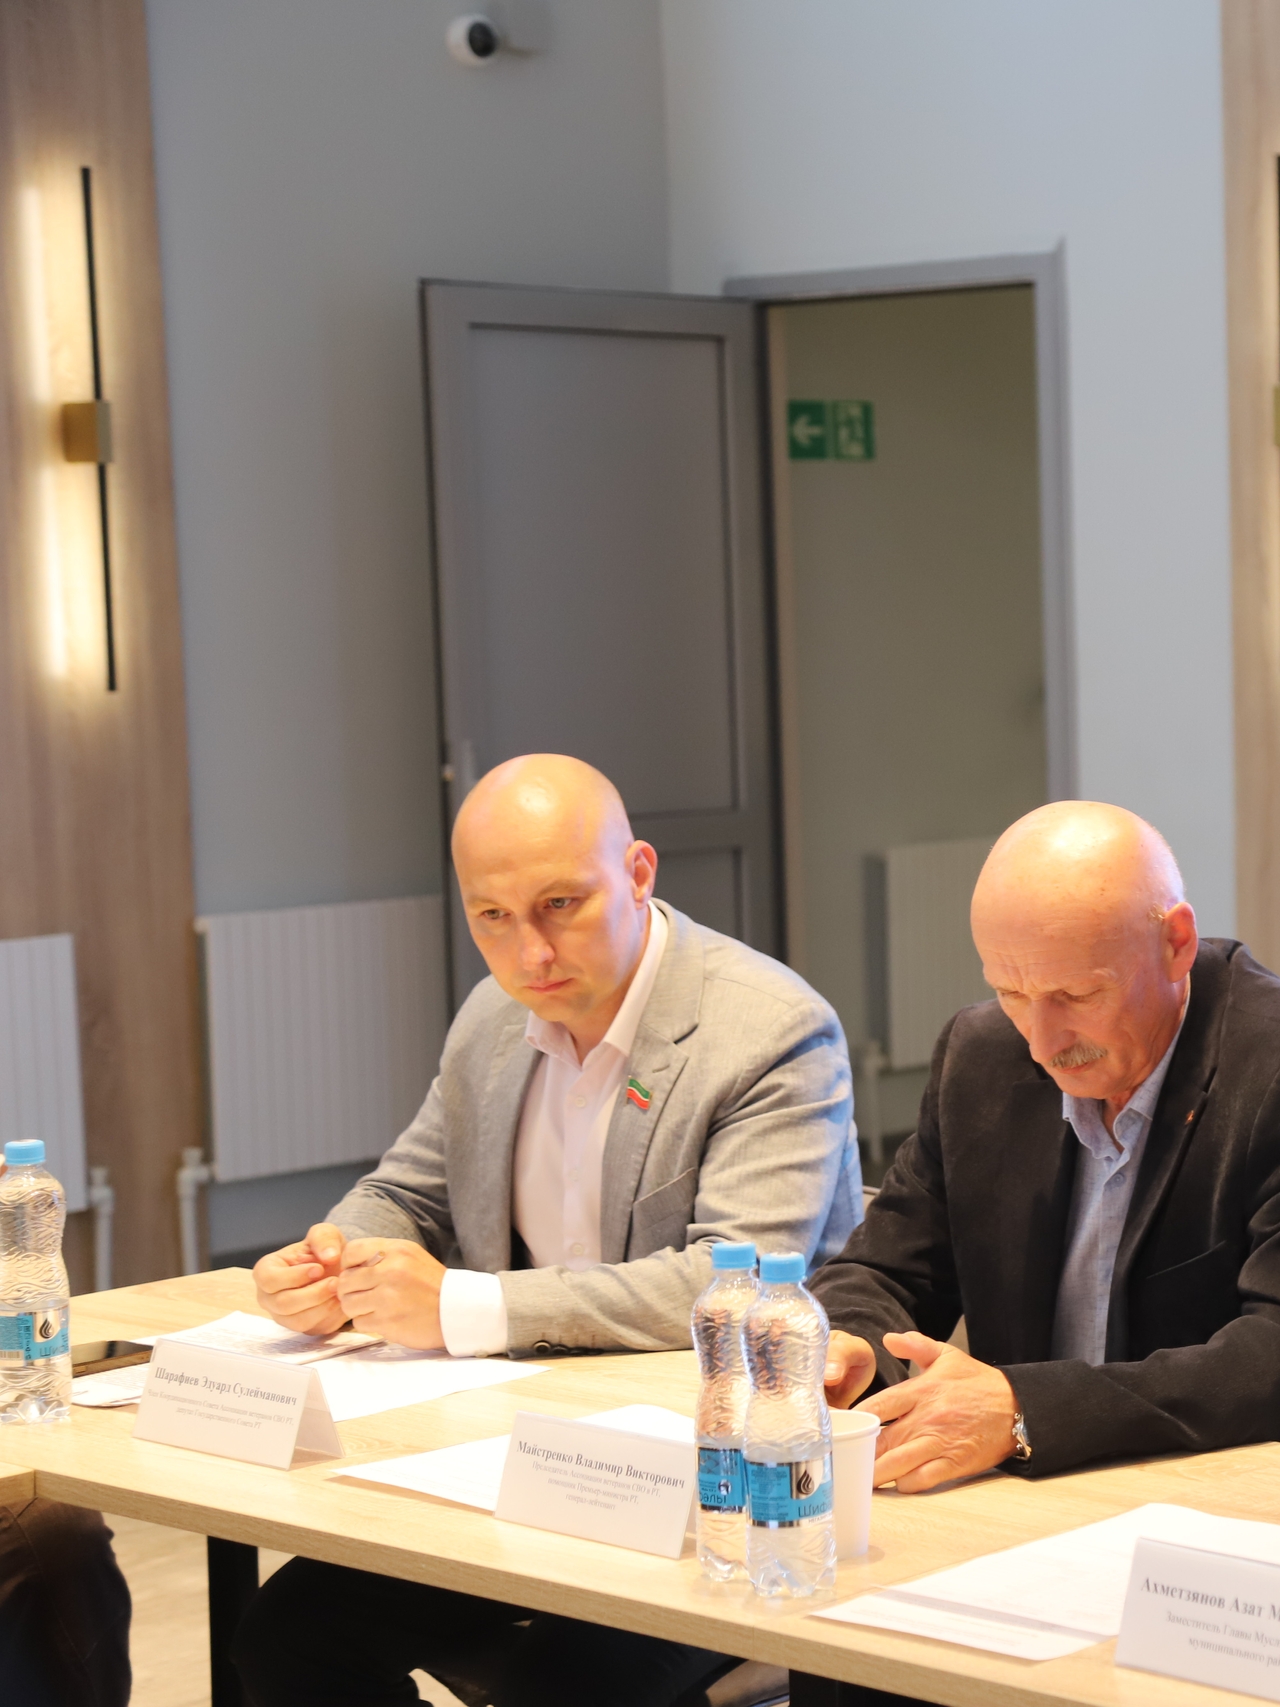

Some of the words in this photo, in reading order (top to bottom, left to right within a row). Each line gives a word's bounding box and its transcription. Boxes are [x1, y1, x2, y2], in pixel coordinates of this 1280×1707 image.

[154, 1366, 200, 1387] Шарафиев
[201, 1375, 232, 1395] Эдуард
[232, 1382, 298, 1406] Сулейманович
[516, 1440, 574, 1465] Майстренко
[575, 1453, 623, 1478] Владимир
[625, 1464, 685, 1489] Викторович
[631, 1482, 647, 1494] СВО
[1140, 1577, 1226, 1610] Ахметзянов
[1229, 1596, 1265, 1618] Азат
[1166, 1610, 1221, 1634] Заместитель
[1223, 1624, 1252, 1642] Главы
[1188, 1637, 1265, 1664] муниципального
